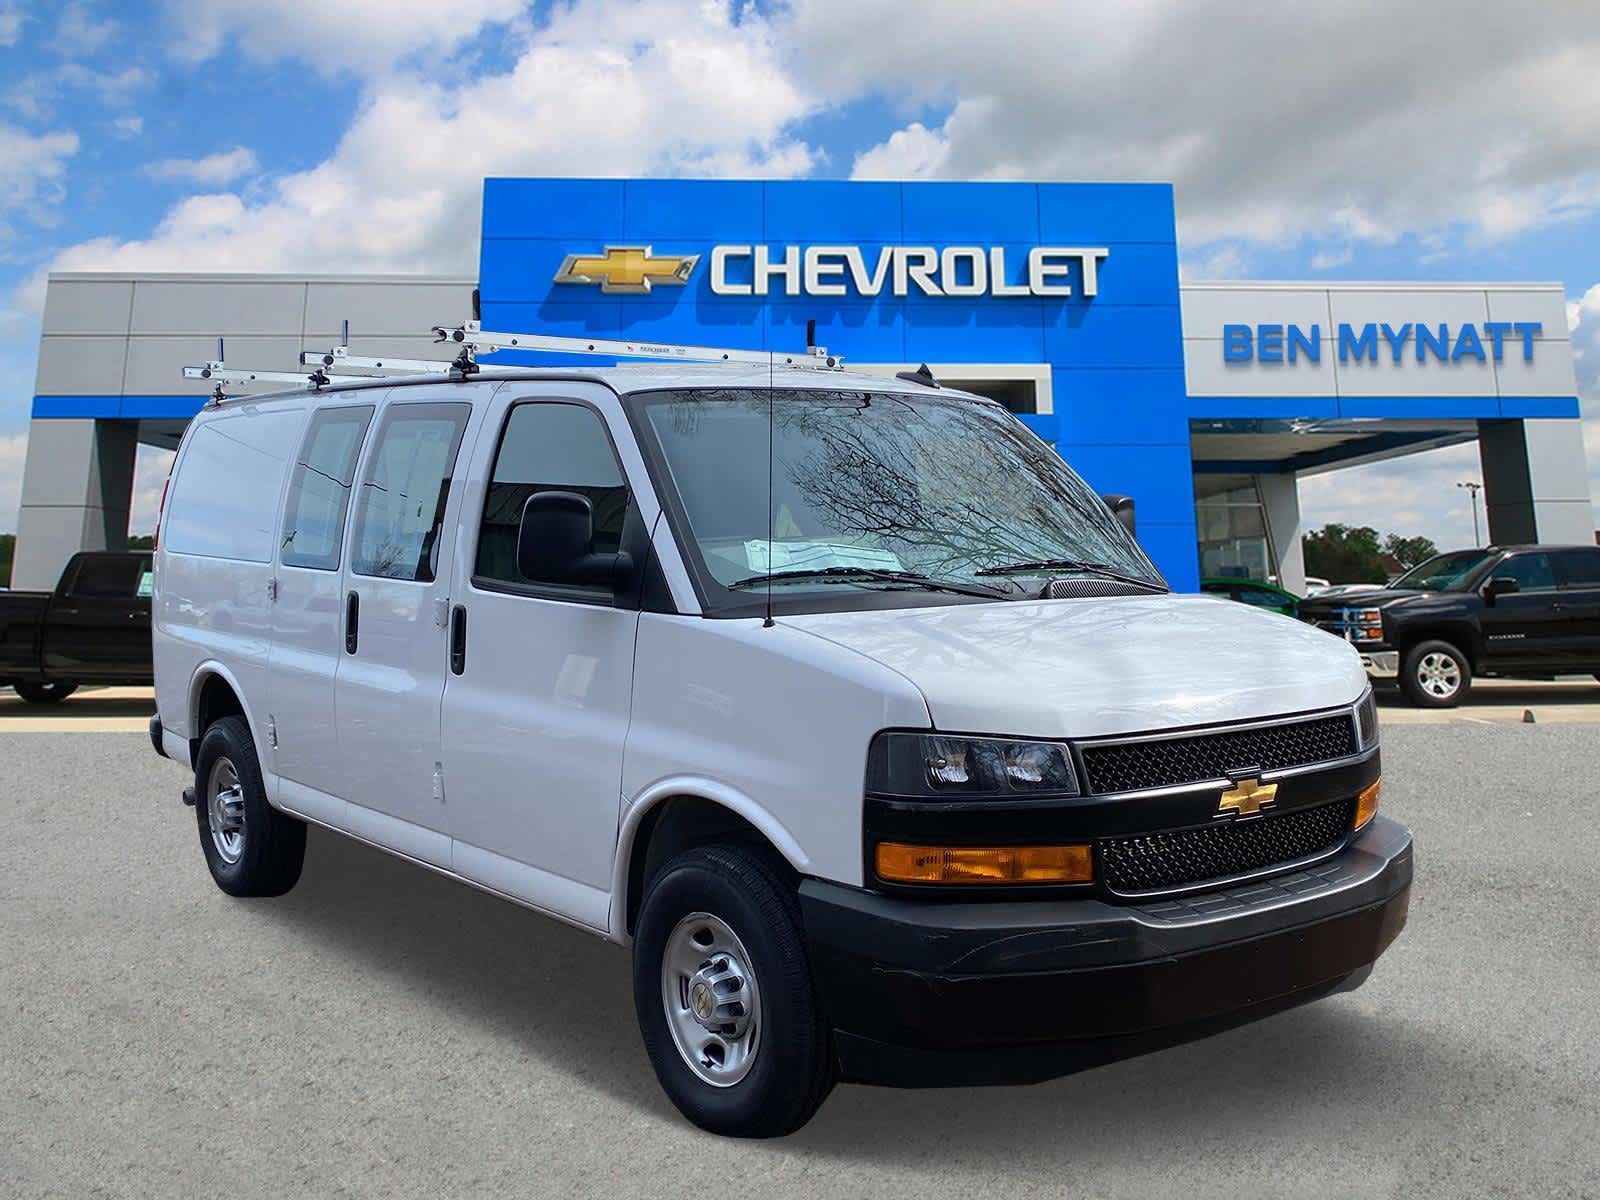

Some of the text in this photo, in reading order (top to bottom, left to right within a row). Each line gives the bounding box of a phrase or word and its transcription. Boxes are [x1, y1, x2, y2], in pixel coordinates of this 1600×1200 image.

[710, 245, 1109, 298] CHEVROLET
[1223, 321, 1542, 363] BEN MYNATT
